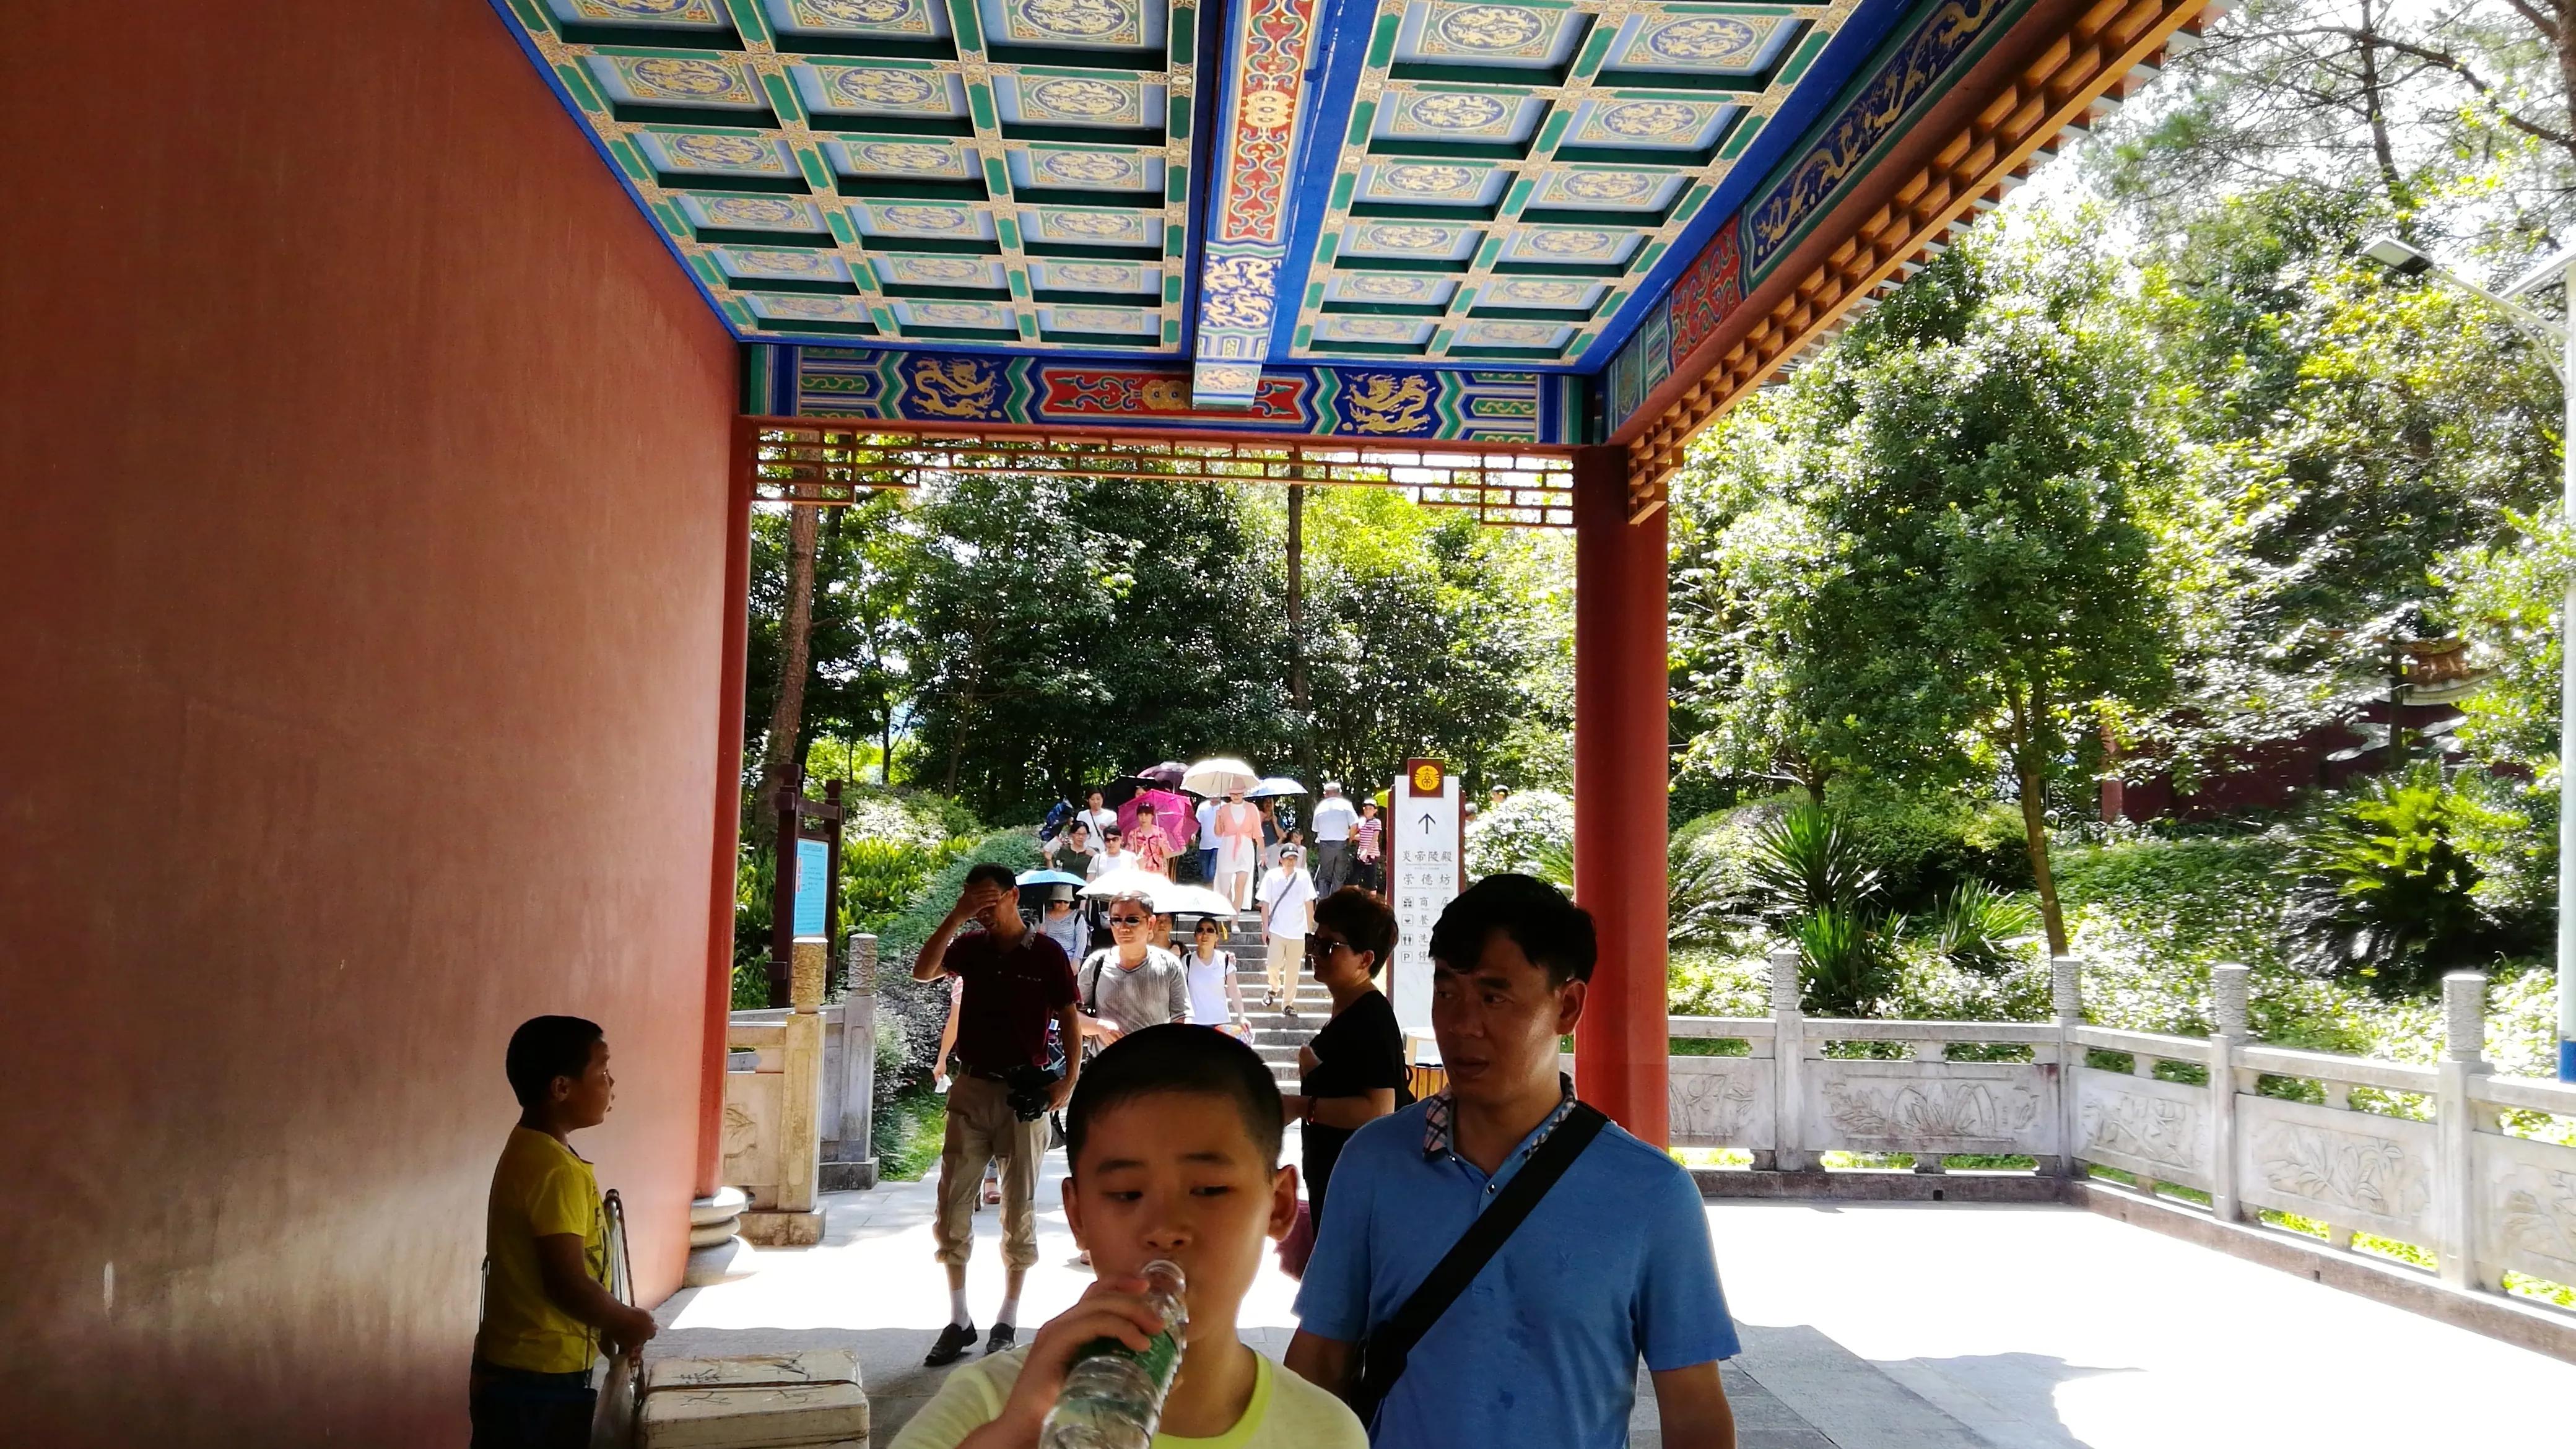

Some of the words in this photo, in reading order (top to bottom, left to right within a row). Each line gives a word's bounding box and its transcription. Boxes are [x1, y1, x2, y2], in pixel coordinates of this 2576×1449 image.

[1402, 850, 1452, 862] 炎帝陵殿
[1403, 874, 1451, 886] 崇德坊
